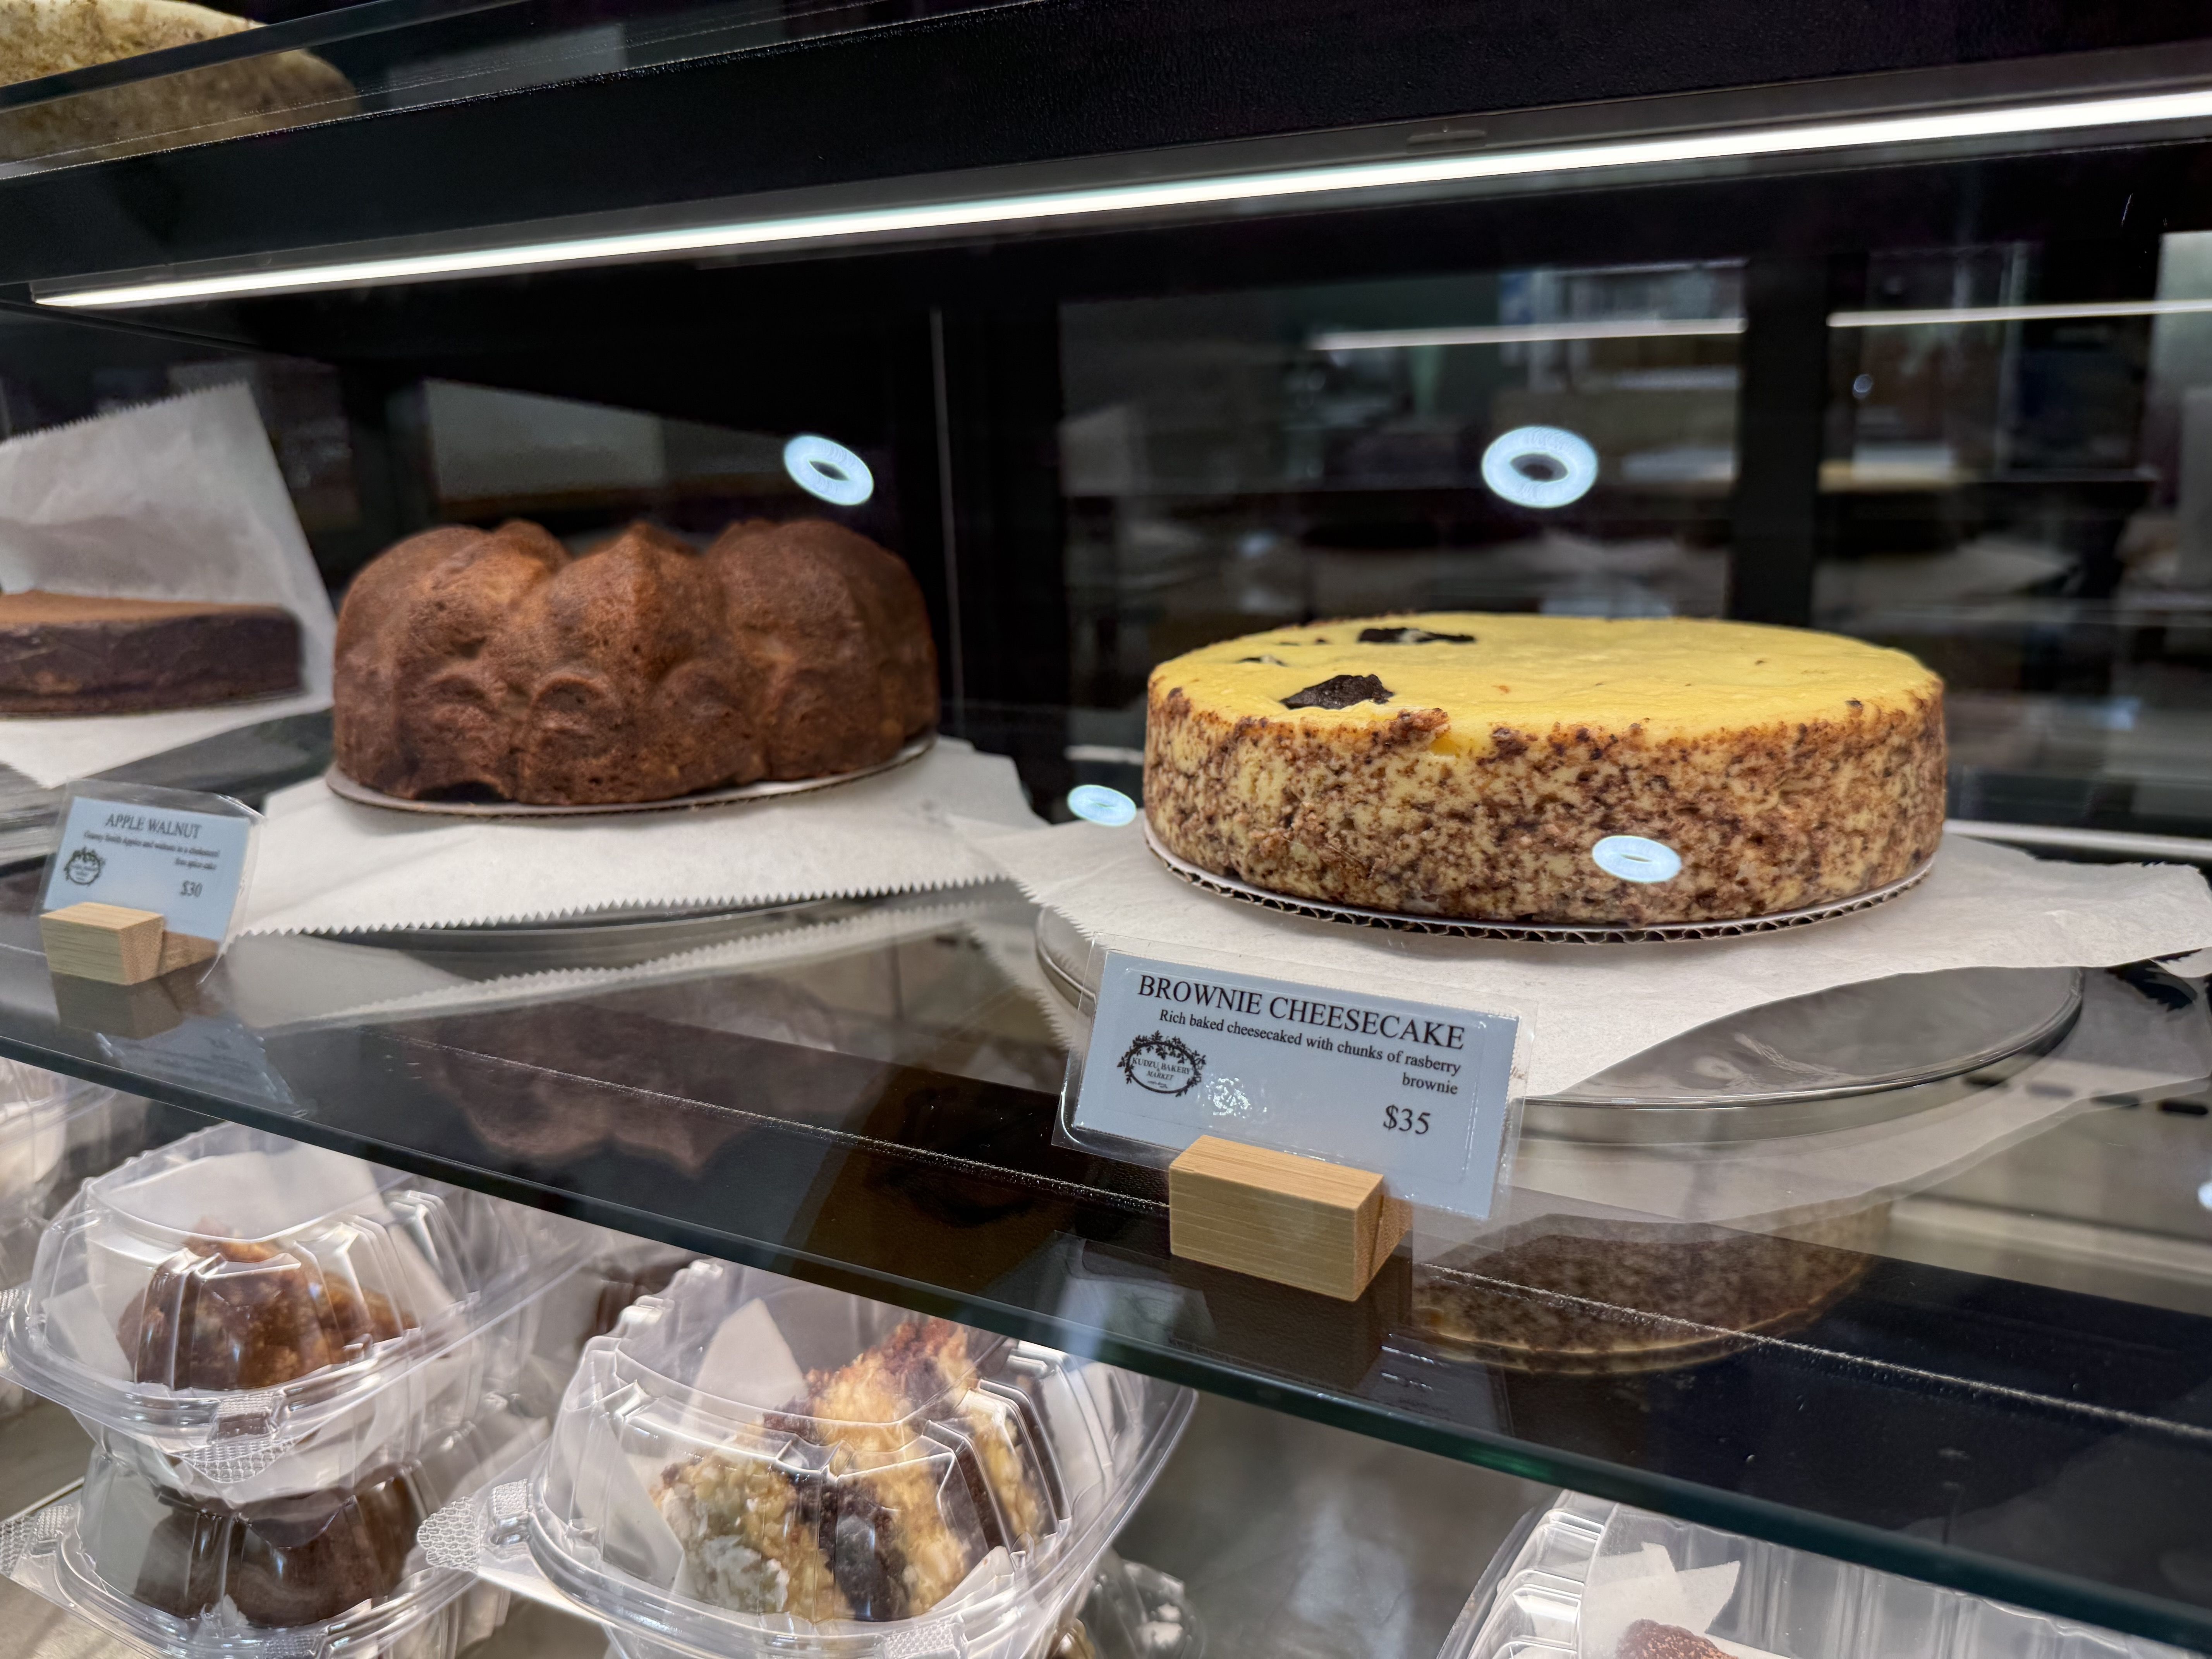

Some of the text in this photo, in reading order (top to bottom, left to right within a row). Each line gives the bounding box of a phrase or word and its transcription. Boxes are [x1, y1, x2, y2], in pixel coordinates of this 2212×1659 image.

[105, 814, 202, 839] APPLE WALNUT
[180, 880, 203, 897] $30
[1137, 974, 1465, 1050] BROWNIE CHEESECAKE
[1159, 1009, 1461, 1076] Rich baked cheesecaked with chunks of rasberry
[1132, 1057, 1190, 1075] KUDZU BAKERY
[1146, 1070, 1174, 1080] MARKET
[1402, 1072, 1458, 1094] brownie
[1383, 1104, 1431, 1135] $35
